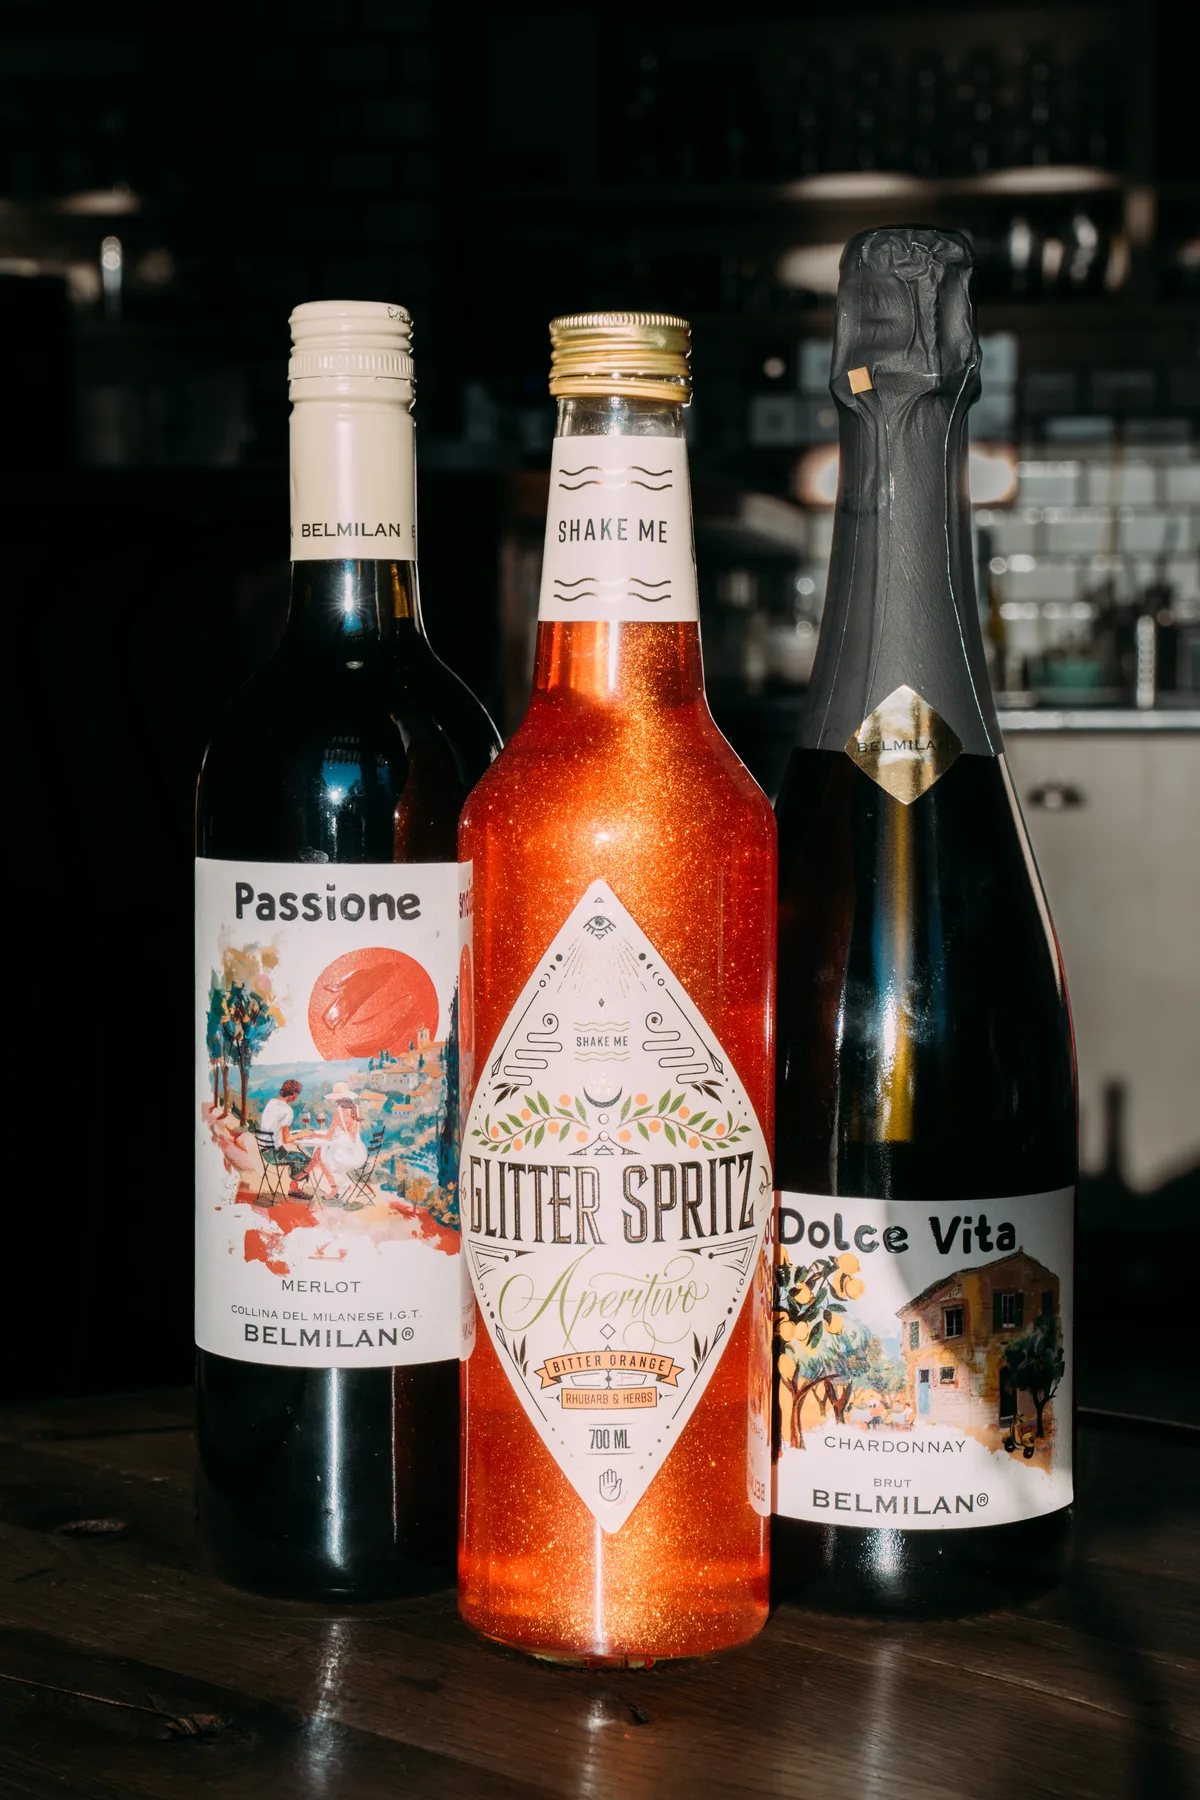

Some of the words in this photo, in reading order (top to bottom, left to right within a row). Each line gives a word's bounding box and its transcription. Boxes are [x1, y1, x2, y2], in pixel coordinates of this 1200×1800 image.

[301, 522, 400, 538] BELMILAN
[558, 518, 628, 544] SHAKE
[639, 518, 668, 544] ME
[235, 881, 422, 922] Passione
[575, 1035, 611, 1048] SHAKE
[613, 1035, 629, 1047] ME
[469, 1154, 606, 1245] GLITTER
[620, 1150, 755, 1245] SPRITZ
[778, 1206, 909, 1254] Dolce
[928, 1213, 1016, 1255] Vita
[281, 1279, 361, 1293] MERLOT
[498, 1246, 709, 1346] Aperitivo
[231, 1304, 278, 1320] COLLINA
[283, 1311, 308, 1321] DEL
[313, 1311, 385, 1322] MILANESE
[389, 1308, 423, 1321] I.G.T.
[552, 1356, 602, 1374] BITTER
[609, 1354, 667, 1372] ORANGE
[565, 1391, 609, 1405] RHUBARB
[612, 1392, 620, 1405] &
[623, 1391, 654, 1404] HERBS
[588, 1428, 611, 1450] 700
[613, 1428, 632, 1450] ML
[824, 1435, 967, 1454] CHARDONNAY
[873, 1477, 912, 1488] BRUT
